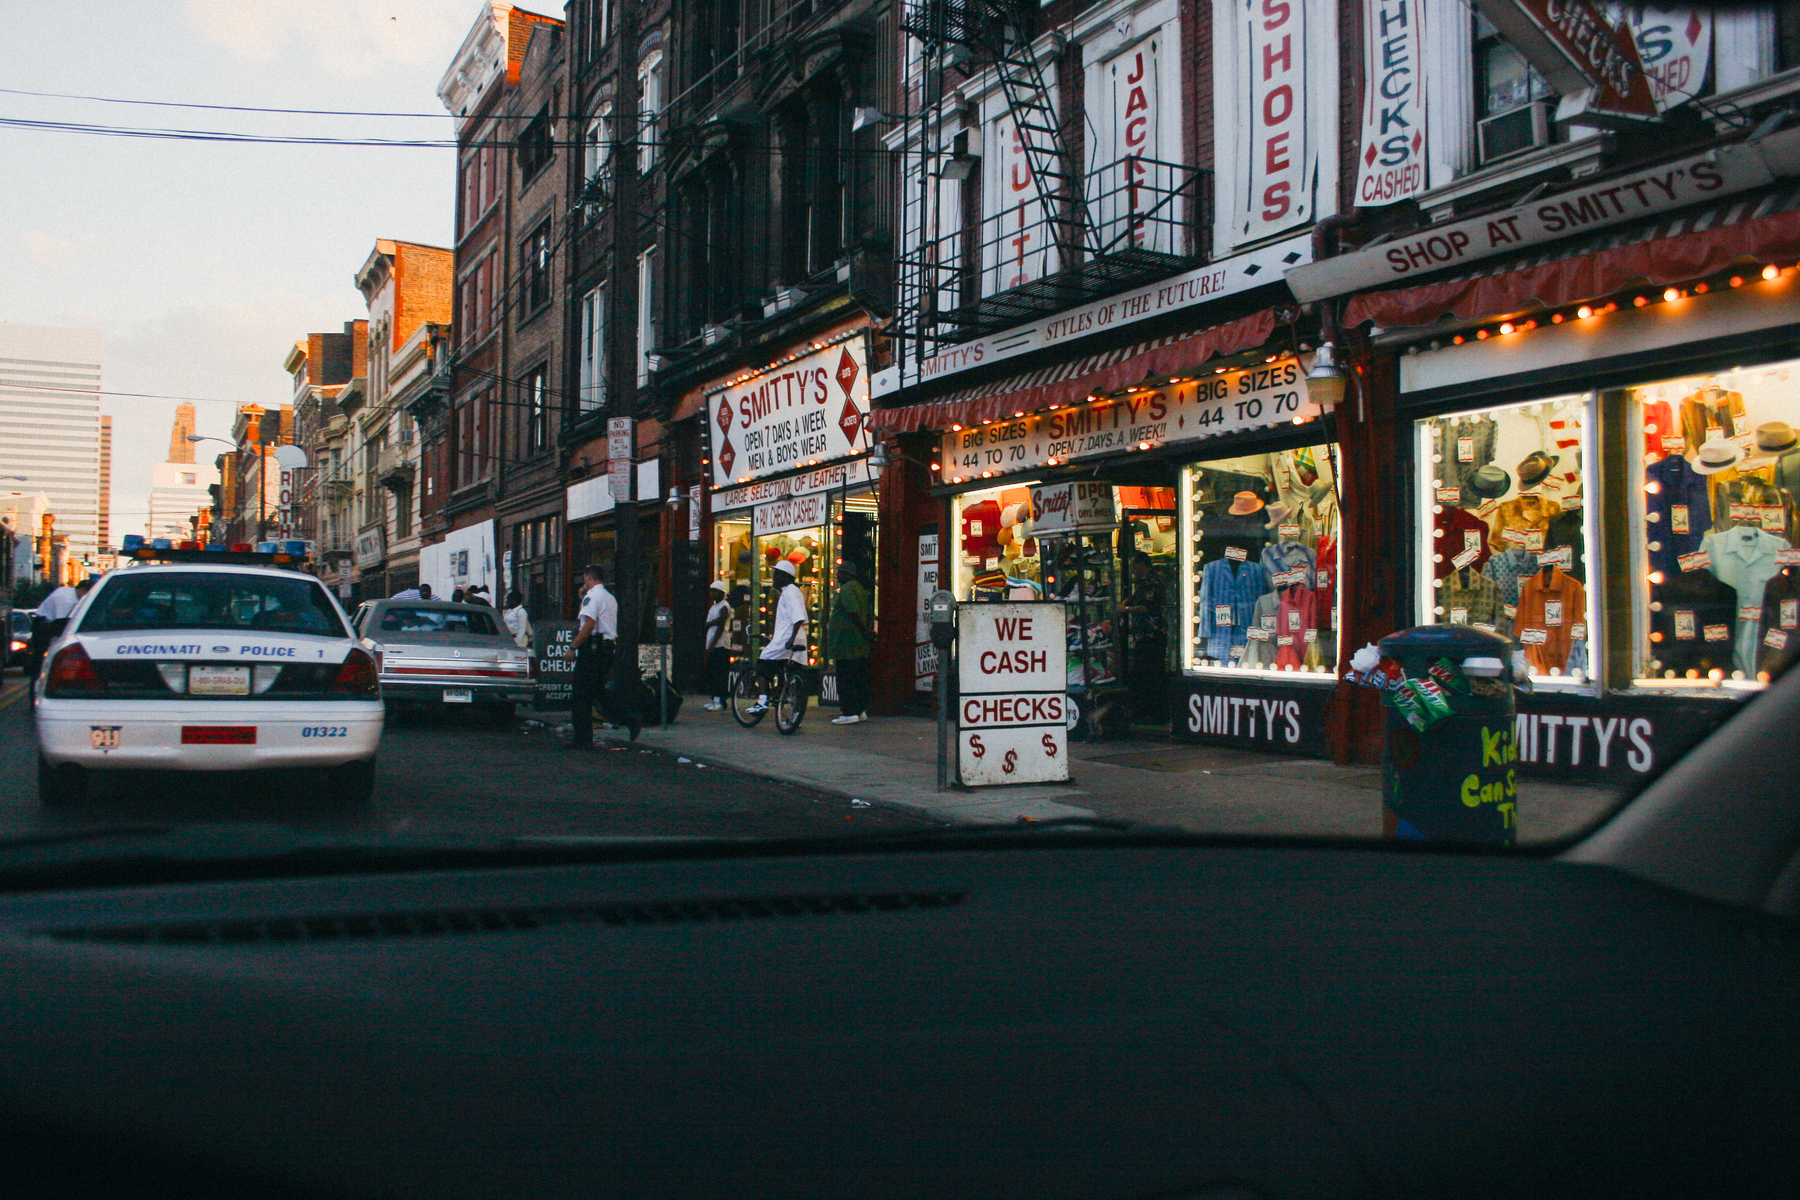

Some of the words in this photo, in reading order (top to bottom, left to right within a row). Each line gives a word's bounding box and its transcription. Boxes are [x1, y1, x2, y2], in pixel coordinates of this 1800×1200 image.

[1379, 0, 1412, 167] HECKS
[1262, 0, 1293, 222] SHOES
[1362, 163, 1421, 202] CASHED
[1386, 230, 1470, 274] SHOP
[1486, 215, 1523, 249] AT
[1536, 161, 1724, 234] SMITTY'S
[1046, 310, 1093, 342] STYLES
[1097, 306, 1116, 326] OF
[1121, 294, 1151, 321] THE
[1156, 270, 1226, 310] FUTURE!
[920, 342, 985, 379] SMITTY'S
[739, 366, 828, 430] SMITTY'S
[1196, 378, 1228, 404] BIG
[1238, 362, 1297, 396] SIZES
[614, 420, 624, 428] NO
[1048, 392, 1167, 440] SMITTY'S
[1198, 408, 1224, 428] 44
[1235, 400, 1262, 421] TO
[1274, 391, 1300, 415] 70
[609, 429, 630, 438] PARKING
[744, 428, 764, 452] OPEN
[764, 426, 771, 448] 7
[772, 420, 792, 444] DAYS
[794, 418, 800, 437] A
[801, 408, 827, 433] WEEK
[963, 429, 984, 450] BIG
[988, 422, 1027, 444] SIZES
[748, 452, 766, 472] MEN
[768, 450, 774, 466] &
[776, 440, 798, 464] BOYS
[800, 434, 826, 456] WEAR
[962, 451, 980, 468] 44
[984, 448, 1003, 465] TO
[1008, 444, 1026, 460] 70
[724, 486, 748, 506] LARGE
[750, 478, 792, 500] SELECTION
[794, 475, 806, 492] OF
[808, 466, 846, 489] LEATHER
[280, 471, 291, 539] ROTH
[760, 508, 768, 530] PAY
[770, 503, 792, 528] CHECKS
[994, 618, 1033, 641] WE
[116, 644, 201, 655] CINCINNATI
[240, 645, 296, 657] POLICE
[317, 649, 324, 658] 1
[918, 645, 931, 660] USE
[980, 650, 1046, 674] CASH
[822, 675, 840, 701] SM
[964, 697, 1062, 724] CHECKS
[1188, 694, 1300, 744] SMITTY'S
[302, 726, 348, 738] 01322
[969, 734, 986, 760] $
[1042, 732, 1058, 758] $
[1002, 748, 1018, 775] $
[1461, 774, 1504, 808] Can
